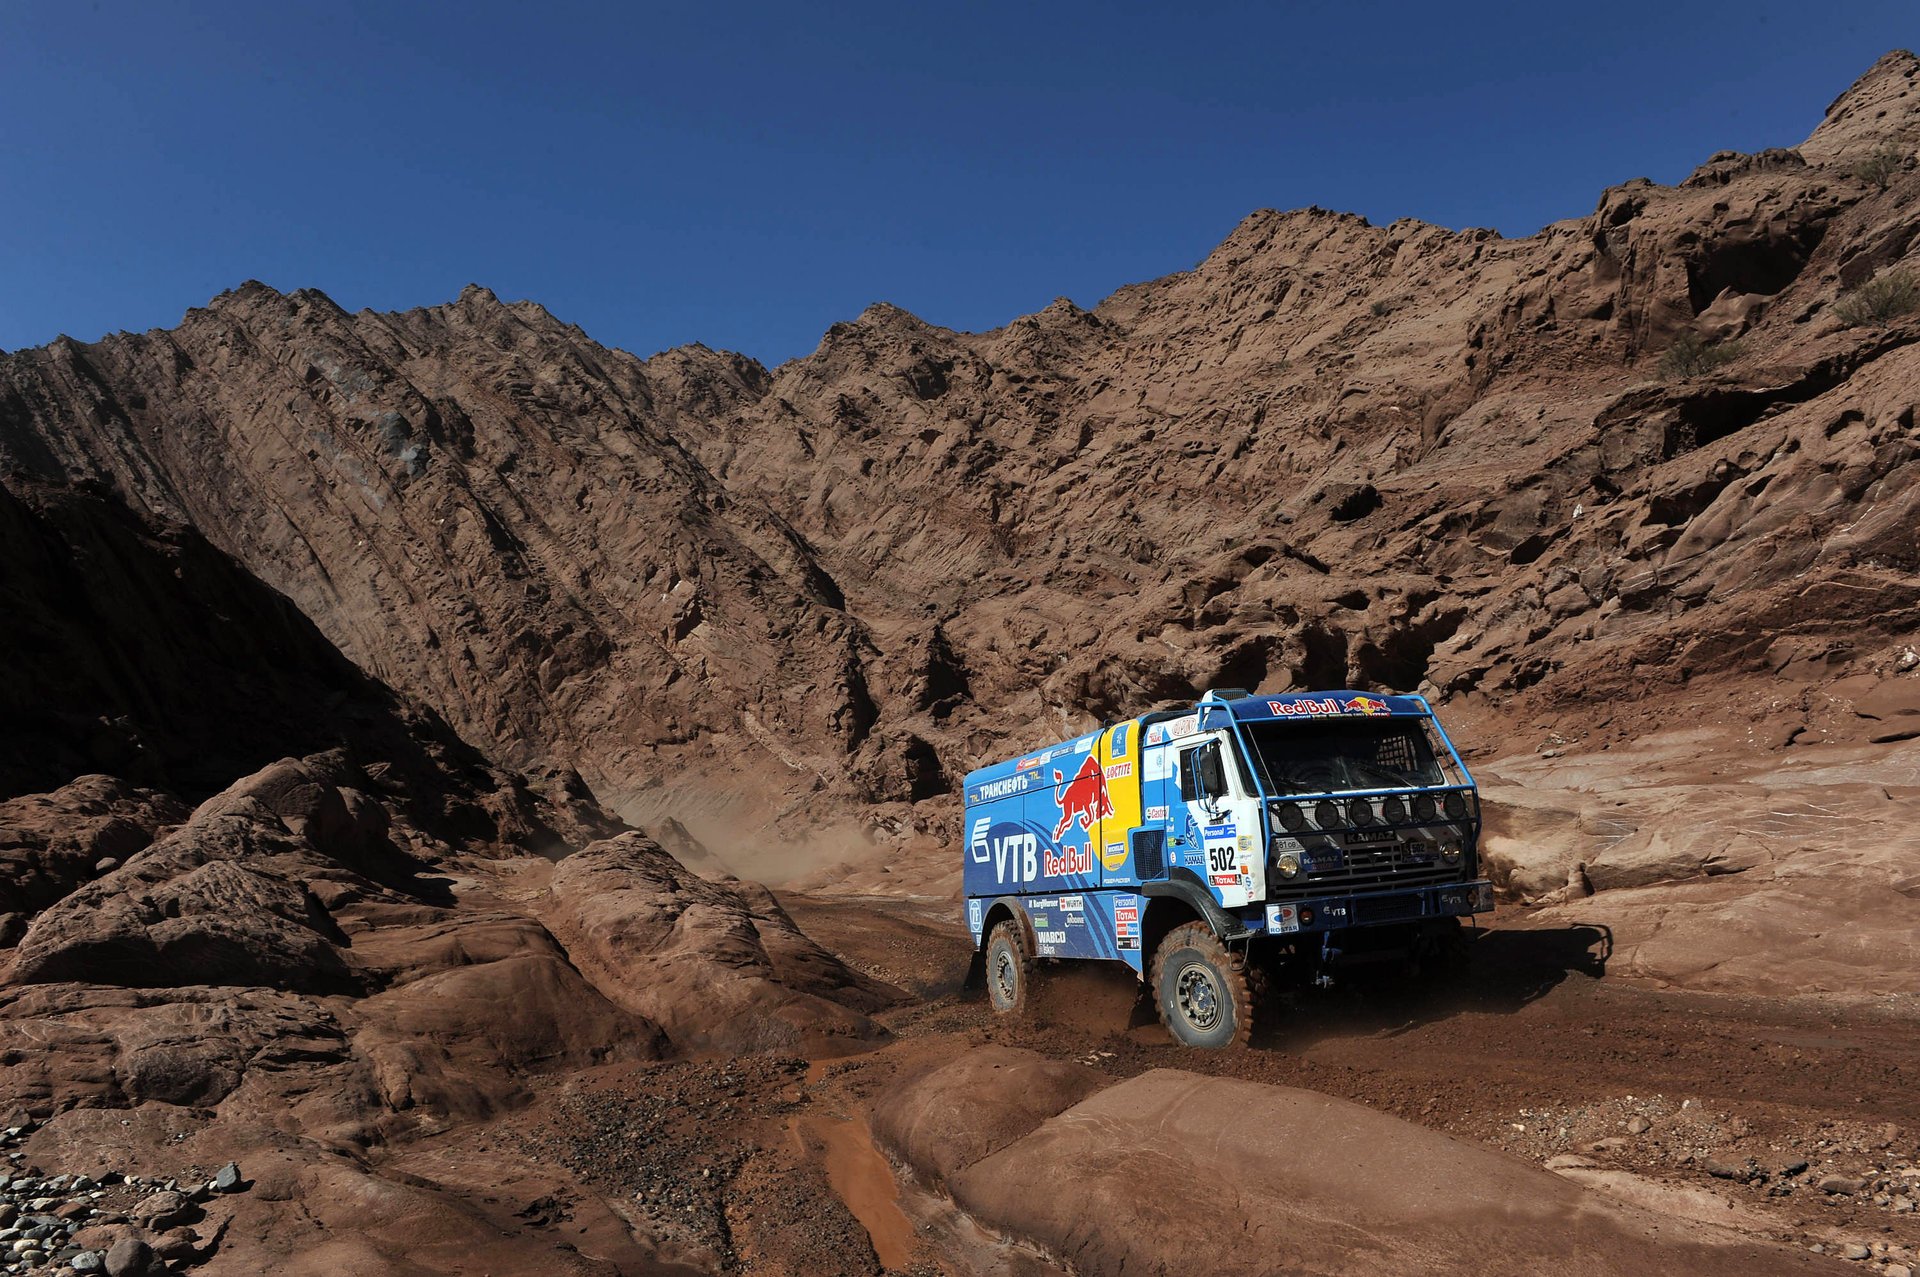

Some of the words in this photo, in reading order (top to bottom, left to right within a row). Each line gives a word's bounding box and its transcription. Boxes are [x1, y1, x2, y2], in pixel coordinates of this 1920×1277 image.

[1106, 763, 1131, 779] LOCTITE
[980, 774, 1028, 801] ТРАНСНЕФТЬ
[1205, 827, 1225, 837] Personal
[1347, 831, 1394, 842] KAMAZ
[994, 833, 1038, 884] VTB
[1209, 846, 1237, 872] 502
[1303, 855, 1338, 865] KAMAZ
[1214, 876, 1236, 884] TOTAL
[1033, 899, 1058, 909] BorgWarner
[1115, 896, 1137, 907] Personal
[1116, 911, 1137, 920] TOTAL
[1331, 907, 1347, 916] VTB
[1038, 931, 1066, 943] WABCO
